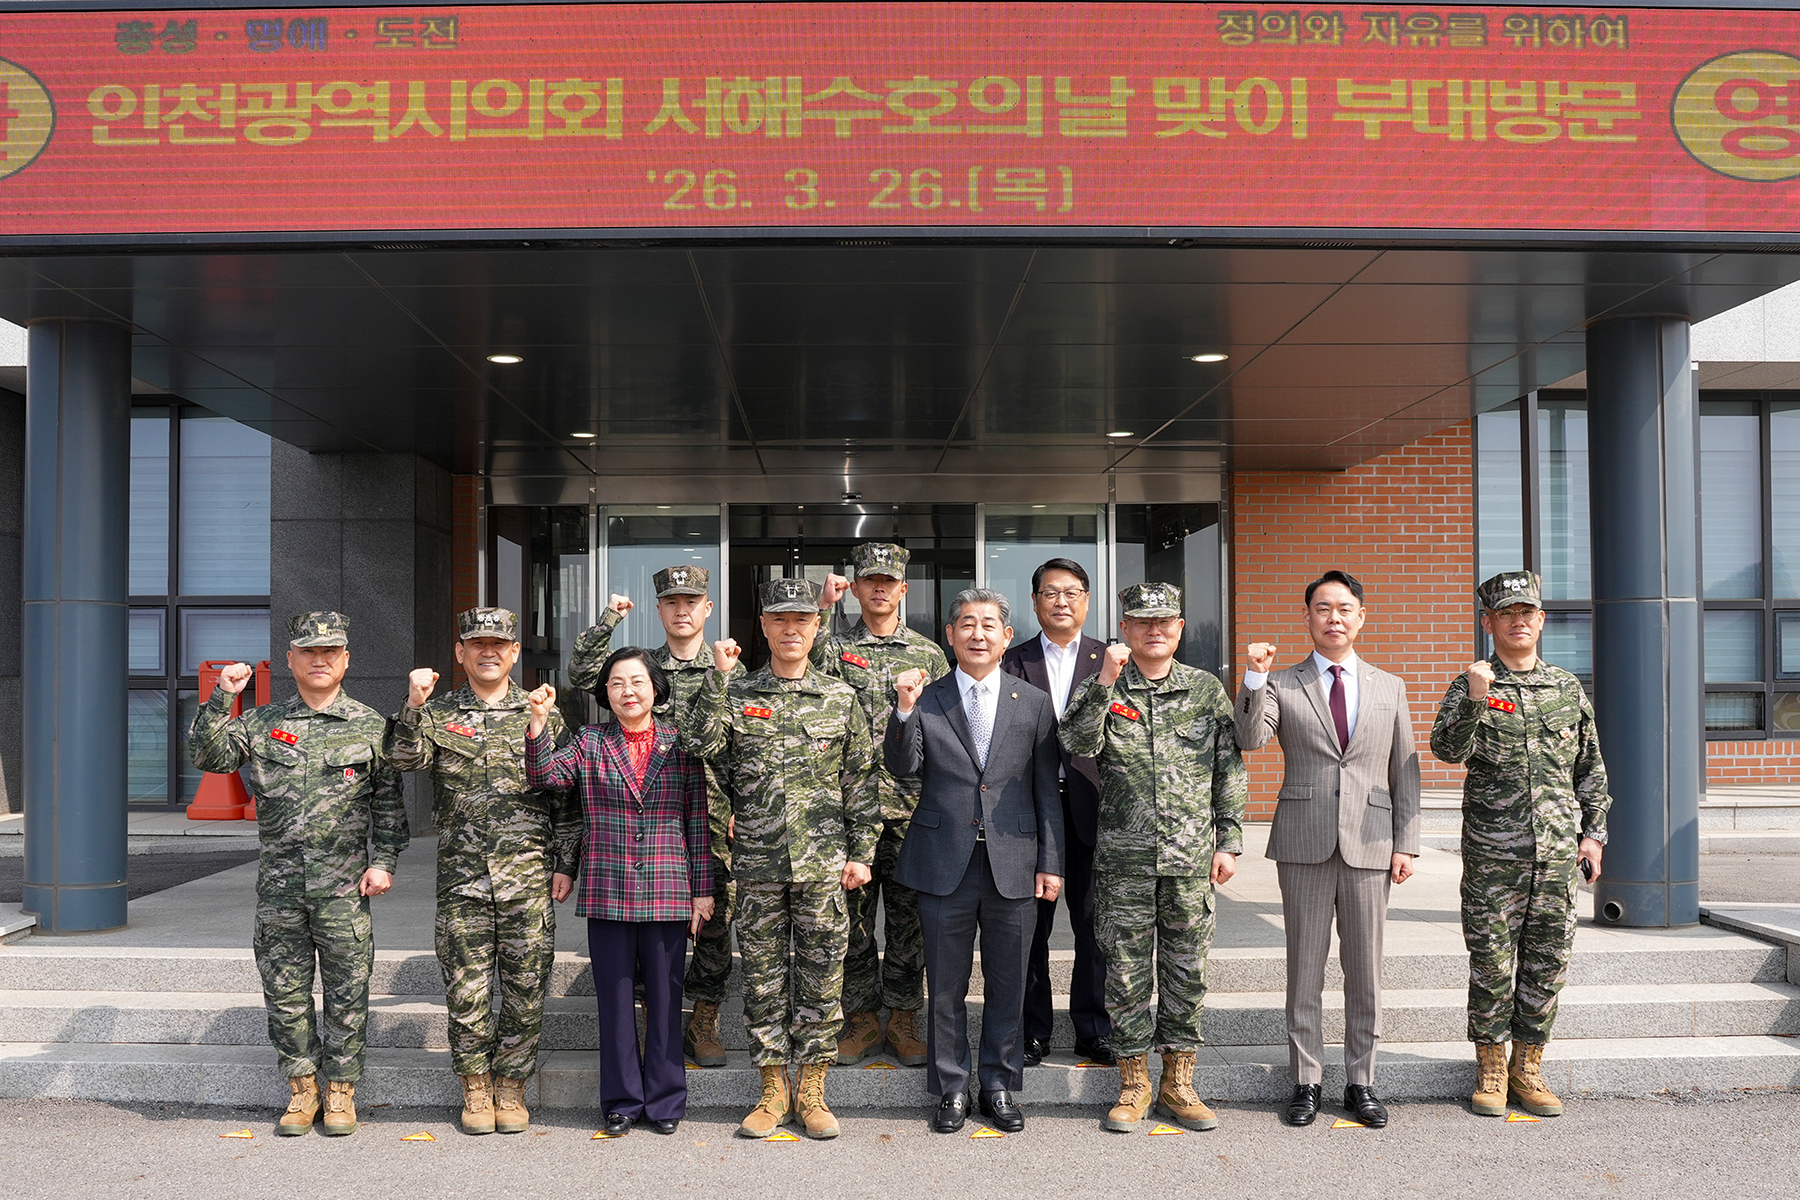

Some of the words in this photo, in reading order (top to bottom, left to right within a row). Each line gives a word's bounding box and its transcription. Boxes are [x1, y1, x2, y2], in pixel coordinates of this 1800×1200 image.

[115, 18, 198, 55] 충성
[245, 17, 329, 53] 명예
[375, 15, 459, 50] 도전
[1216, 11, 1348, 47] 정의와
[1360, 12, 1488, 48] 자유를
[1503, 14, 1630, 51] 위하여
[86, 77, 624, 146] 인천광역시의회
[1152, 76, 1309, 140] 맞이
[1332, 77, 1643, 145] 부대방문
